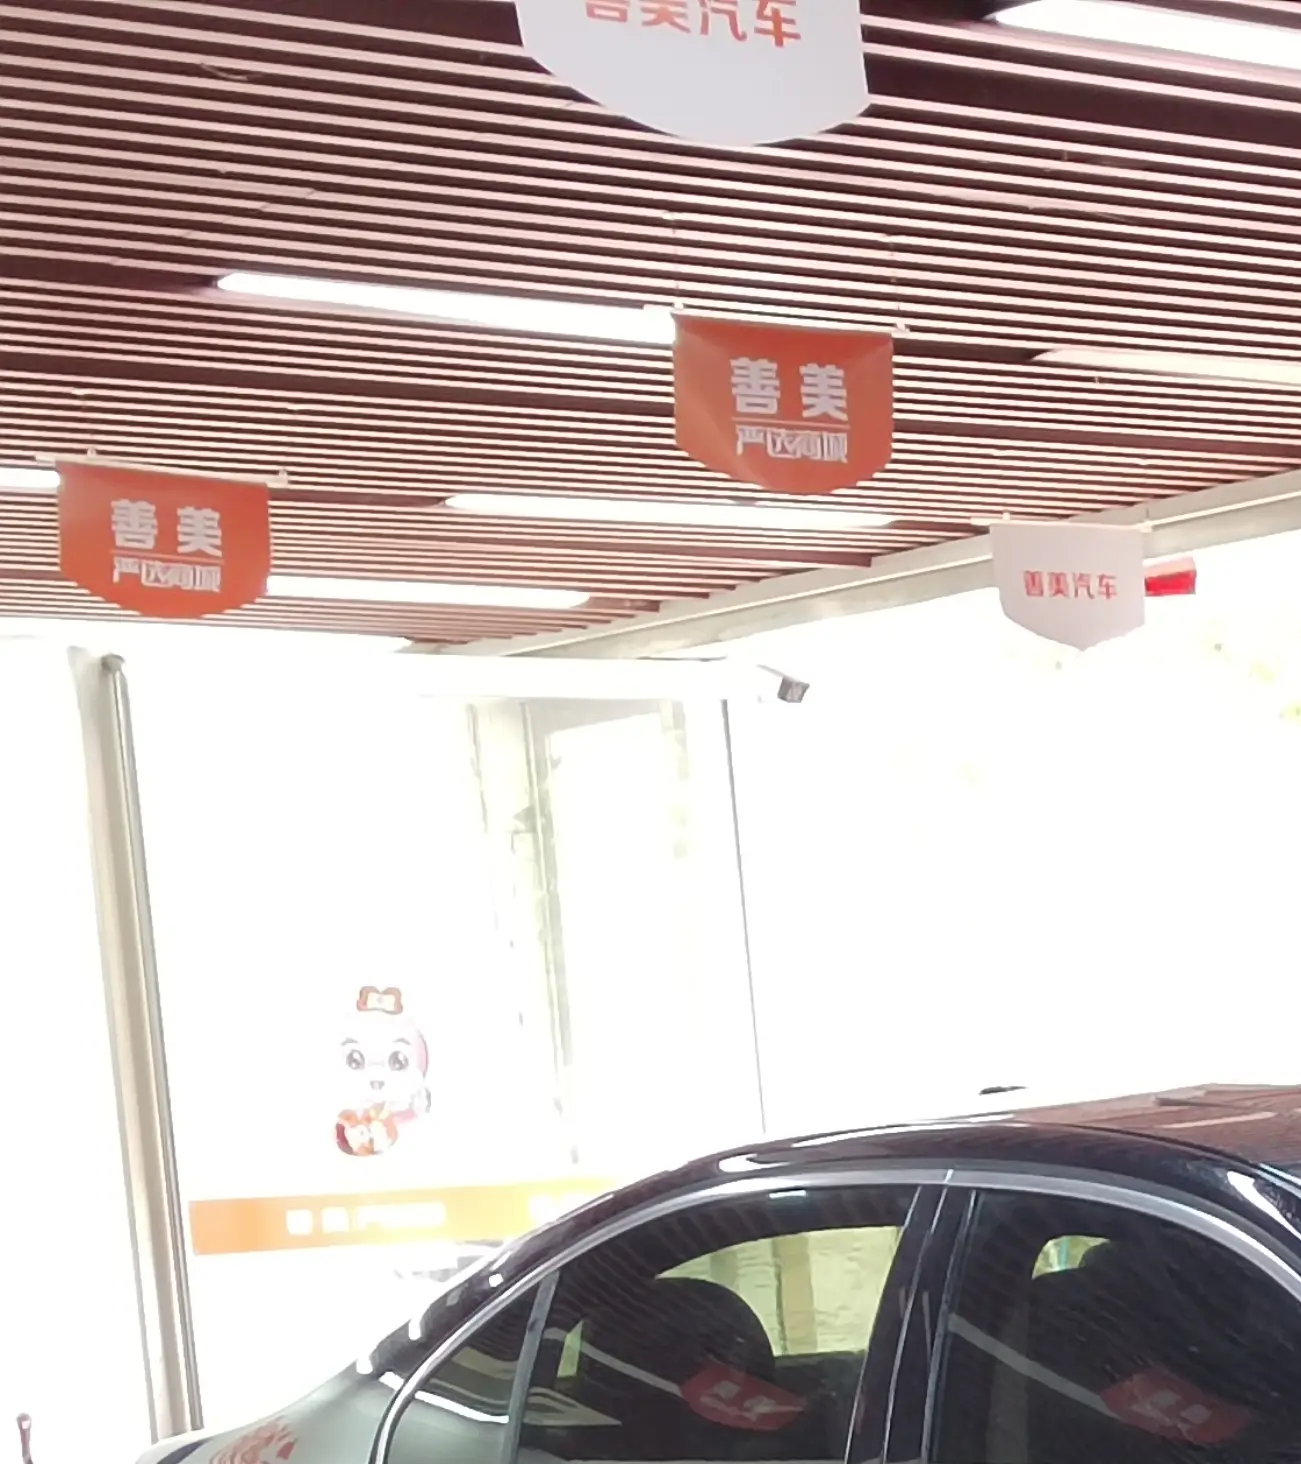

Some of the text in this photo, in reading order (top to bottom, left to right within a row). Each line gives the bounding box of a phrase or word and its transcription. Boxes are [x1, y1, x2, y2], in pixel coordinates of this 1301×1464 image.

[729, 356, 849, 421] 善美
[110, 499, 223, 558] 善美
[1022, 568, 1118, 600] 善美汽车
